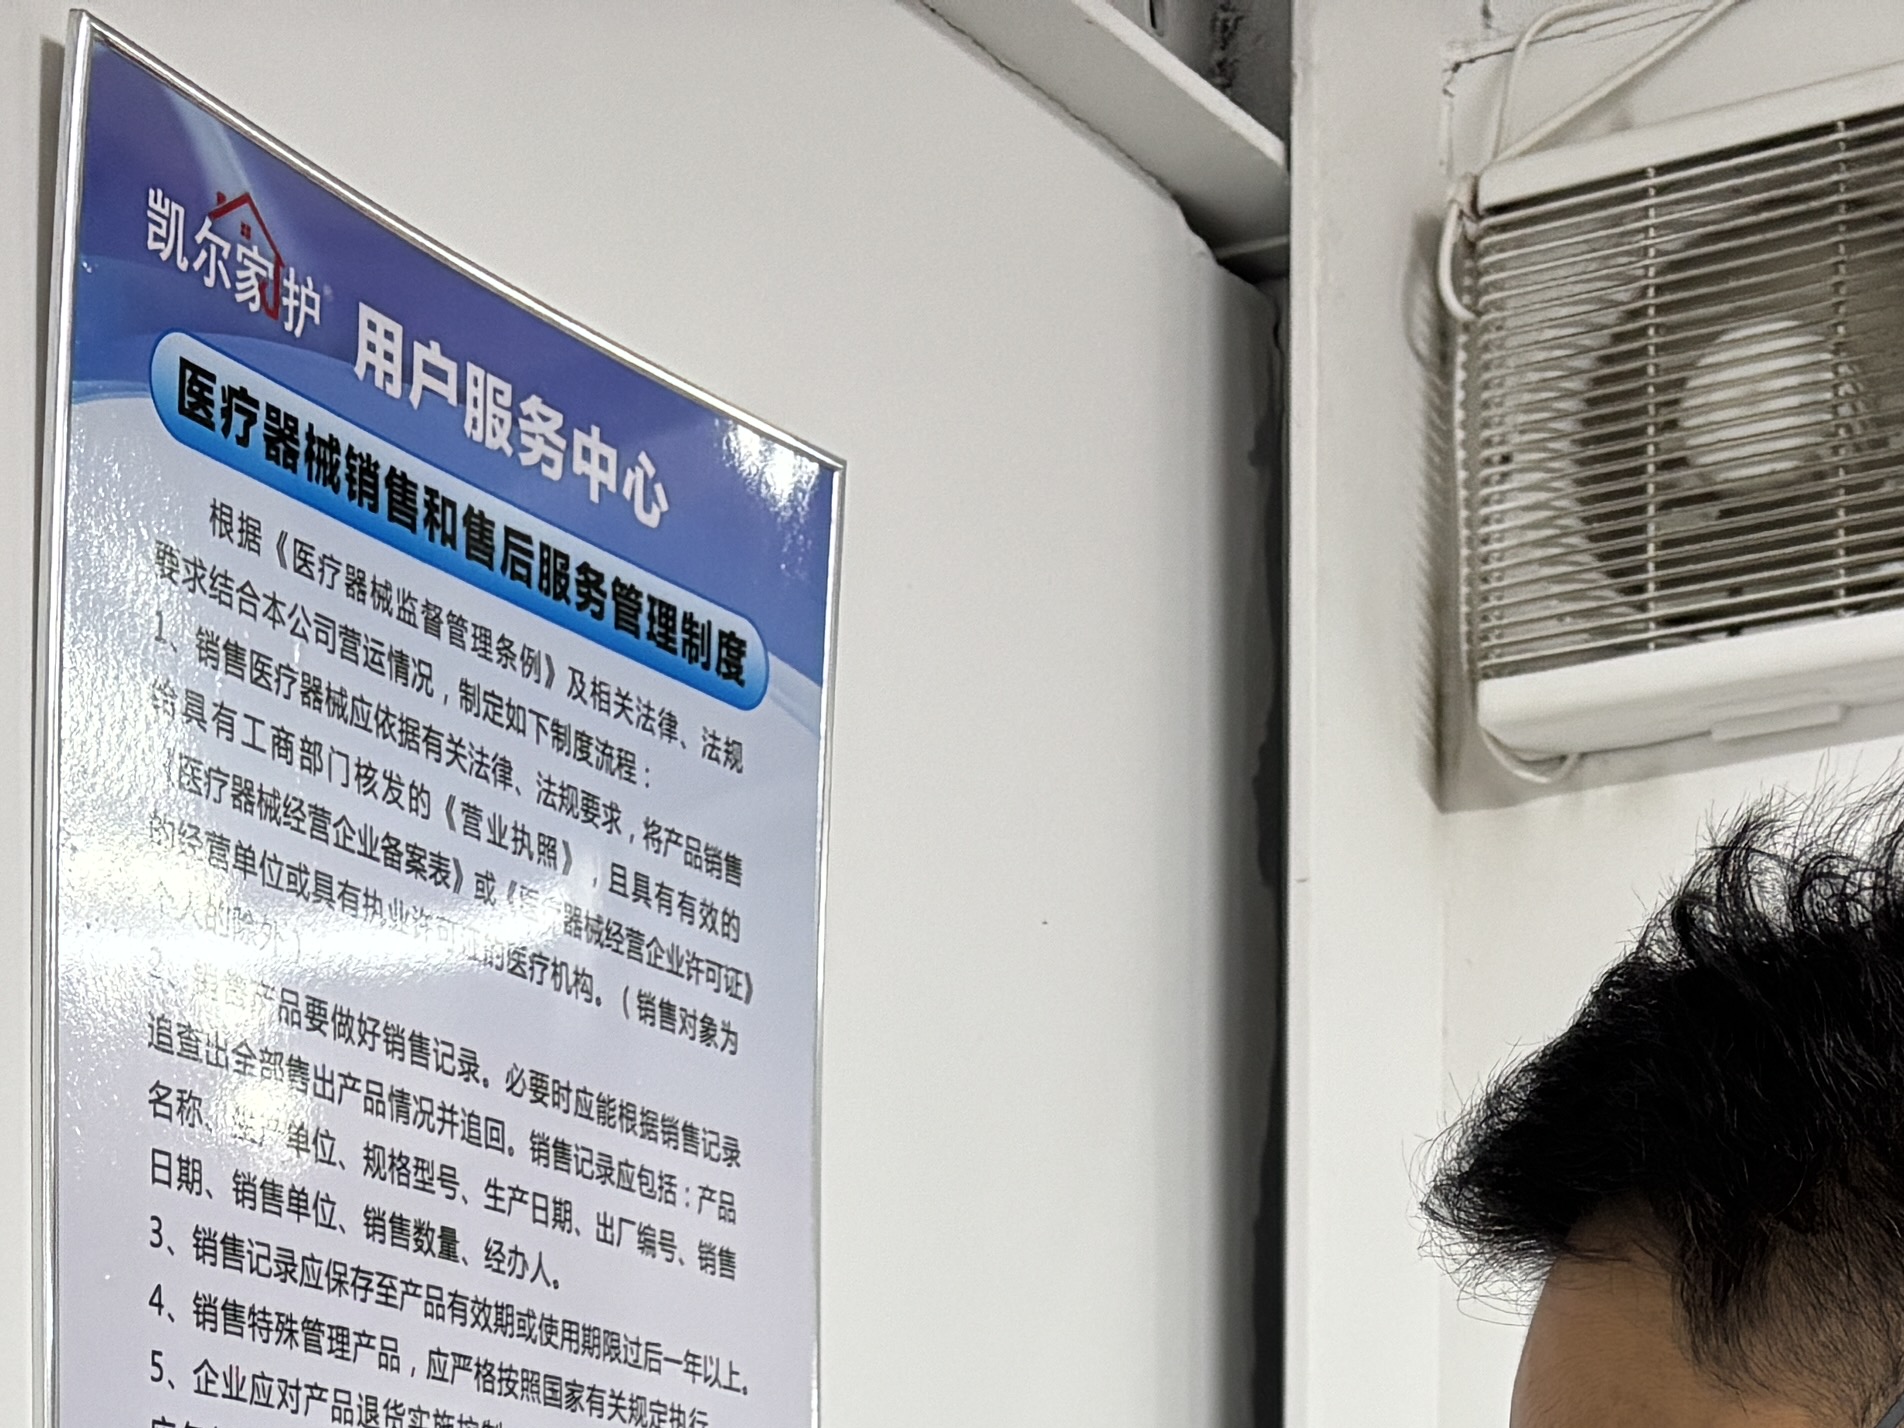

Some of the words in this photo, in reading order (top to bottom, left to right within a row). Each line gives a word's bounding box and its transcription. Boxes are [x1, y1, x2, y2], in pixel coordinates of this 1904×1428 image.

[147, 187, 321, 338] 凯尔家护
[354, 301, 671, 530] 用户服务中心
[176, 355, 749, 689] 医疗器械销售和售后服务管理制度
[149, 1213, 750, 1396] 3、销售记录应保存至产品有效期或使用期限过后一年以上。
[151, 1146, 561, 1291] 日期、销售单位、销售数量、经办人。
